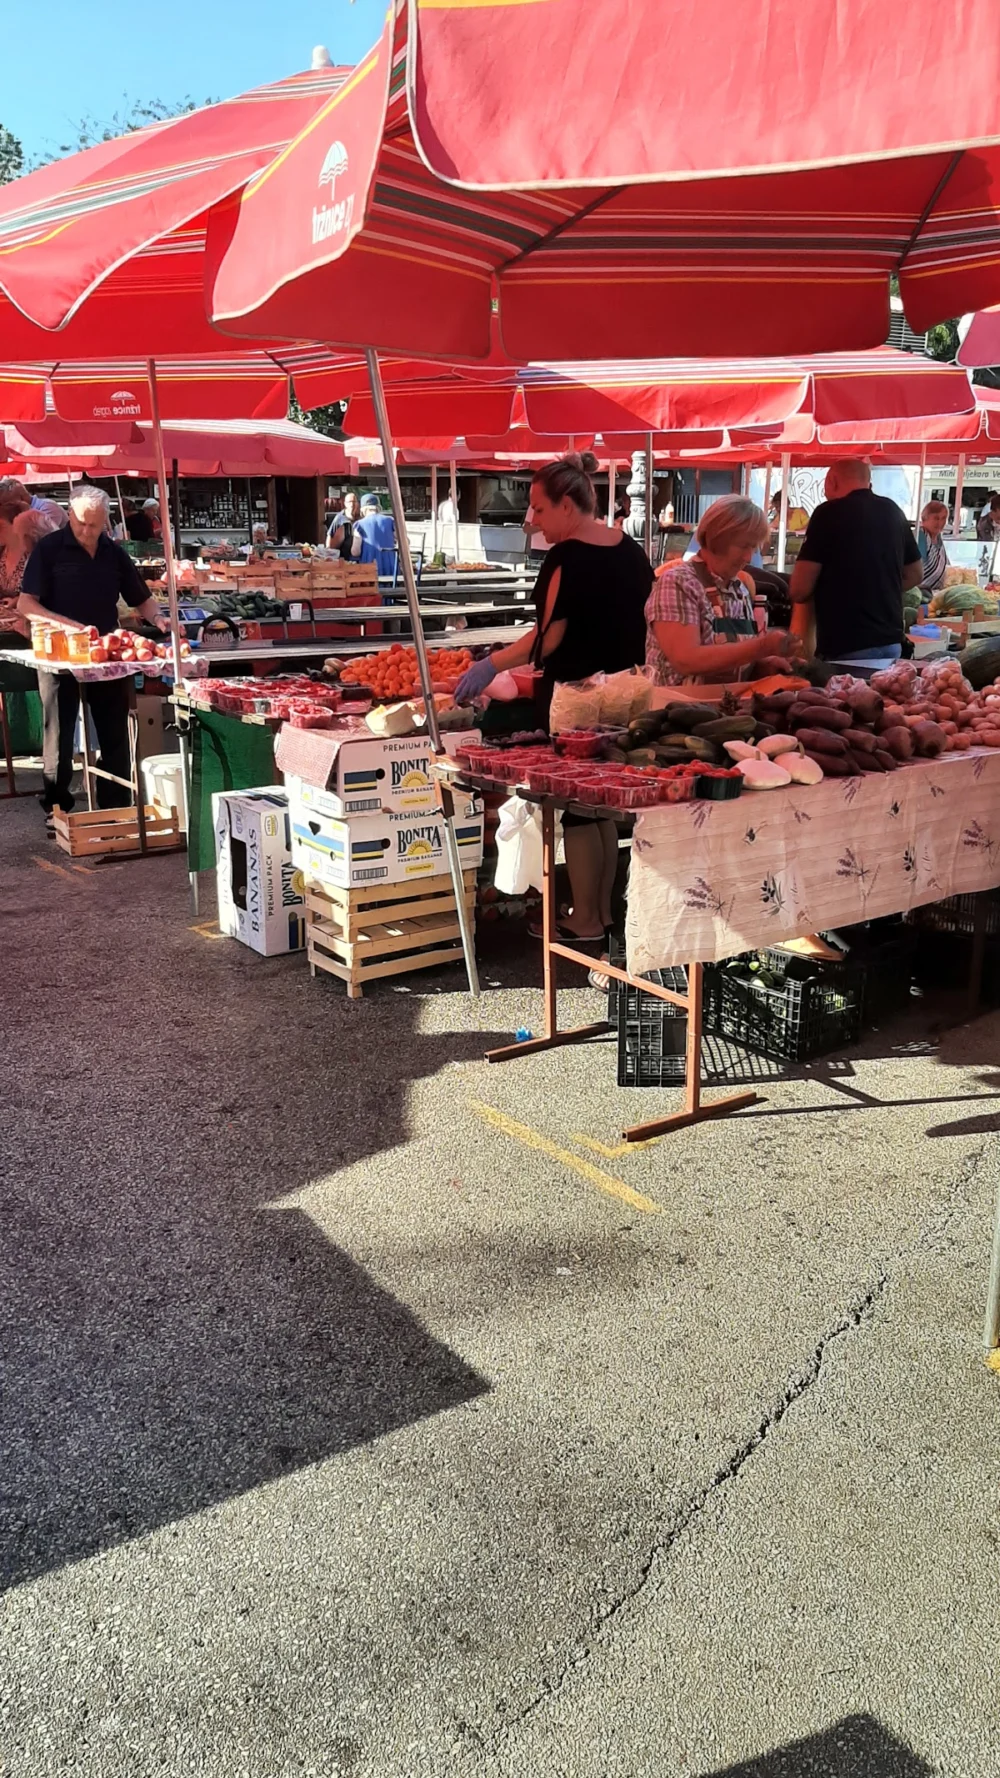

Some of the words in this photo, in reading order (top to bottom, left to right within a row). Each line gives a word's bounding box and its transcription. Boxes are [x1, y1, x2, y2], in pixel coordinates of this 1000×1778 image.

[963, 469, 989, 479] ljekara
[383, 742, 421, 752] PREMIUM
[390, 758, 431, 786] BONIT
[389, 811, 426, 821] PREMIUM
[397, 825, 443, 854] BONITA
[266, 854, 274, 876] PACK
[249, 828, 260, 932] BANANAS
[282, 861, 304, 907] BONITA
[267, 881, 275, 917] PREMIUM
